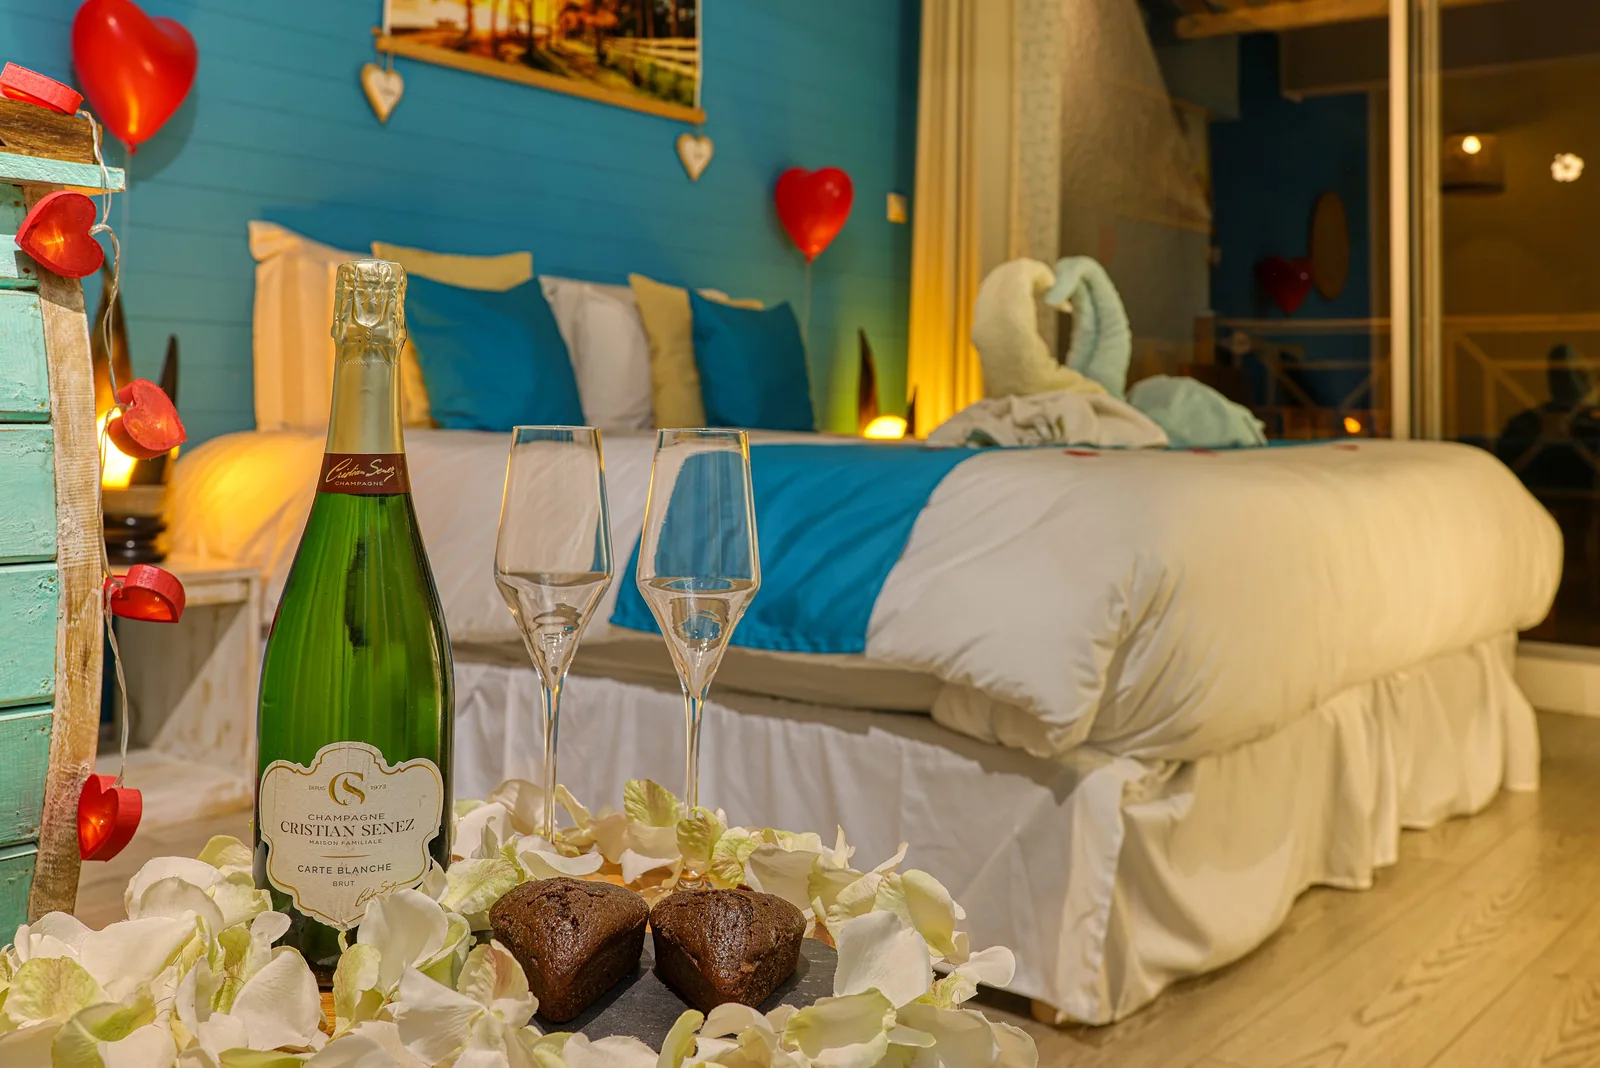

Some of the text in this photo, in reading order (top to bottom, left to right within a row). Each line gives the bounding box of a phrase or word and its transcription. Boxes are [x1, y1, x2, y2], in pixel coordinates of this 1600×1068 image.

[307, 813, 385, 822] CHAMPAGNE
[280, 818, 415, 837] CRISTIAN SENEZ
[297, 863, 392, 875] CARTE BLANCHE
